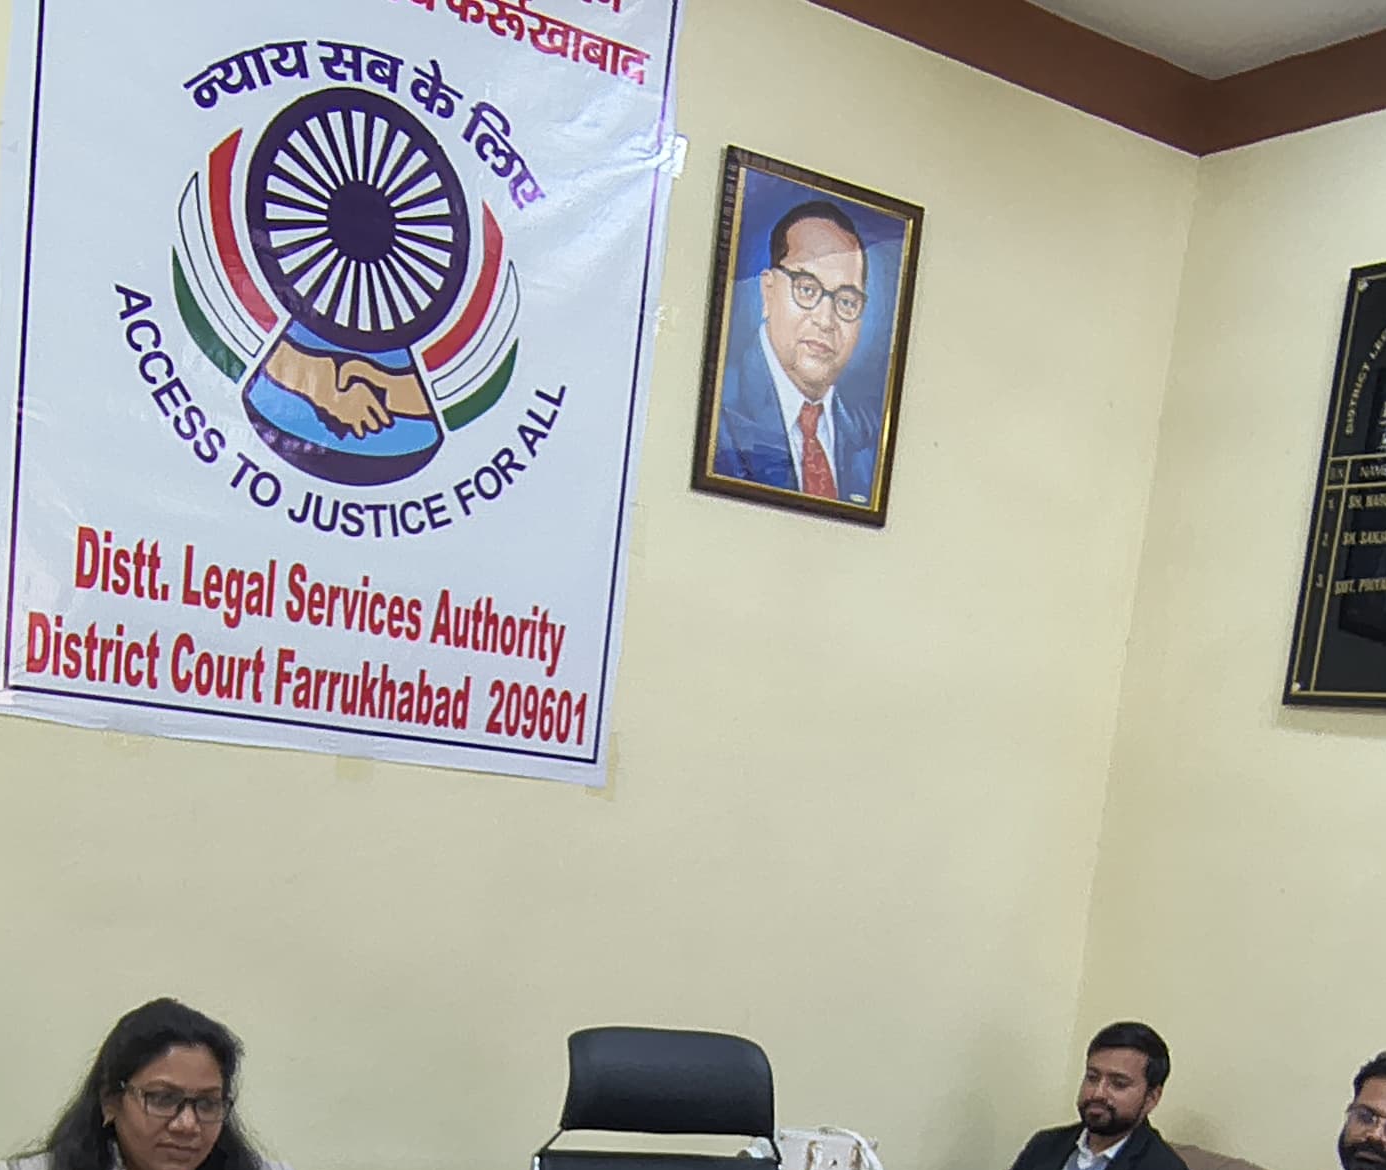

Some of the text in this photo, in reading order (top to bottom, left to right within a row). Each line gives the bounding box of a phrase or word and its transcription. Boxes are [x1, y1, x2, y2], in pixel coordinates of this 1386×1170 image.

[183, 40, 546, 210] न्याय सब के लिए
[115, 283, 567, 538] ACCESS TO JUSTICE FOR ALL
[25, 611, 588, 746] District Court Farrukhabad 209601
[75, 526, 566, 677] Distt. Legal Services Authority
